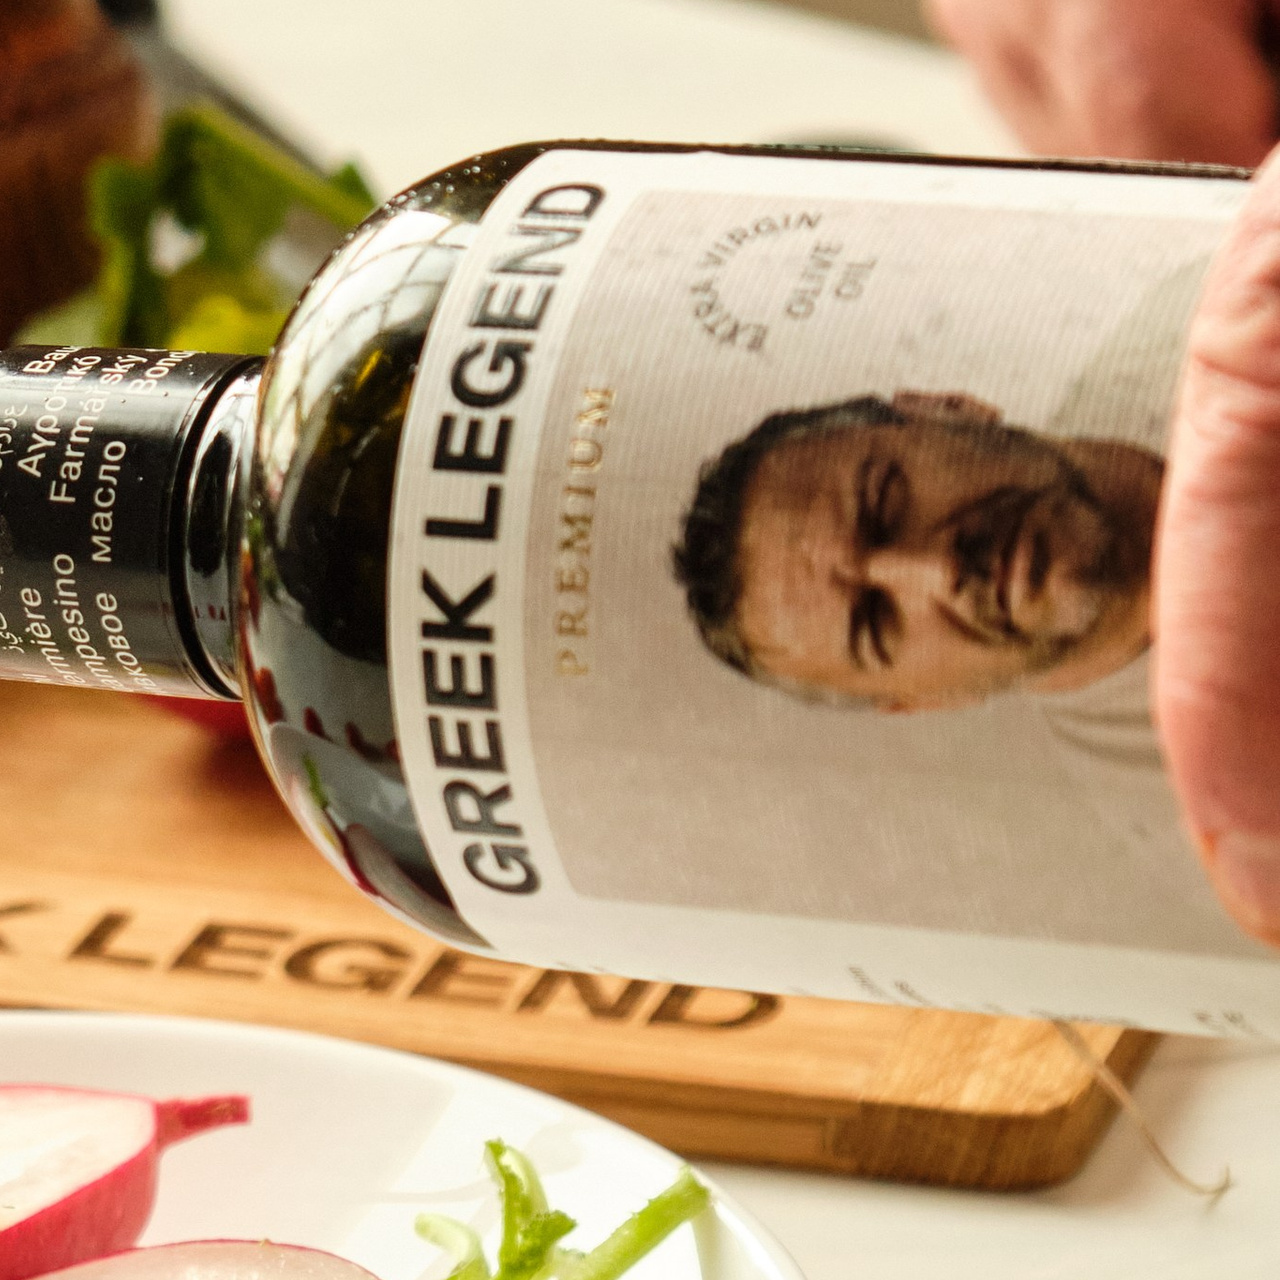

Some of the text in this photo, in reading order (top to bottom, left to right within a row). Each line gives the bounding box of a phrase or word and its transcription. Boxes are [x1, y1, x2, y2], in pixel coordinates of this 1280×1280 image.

[689, 213, 823, 353] EXTRA VIRGIN
[783, 242, 844, 321] OLIVE
[834, 258, 878, 300] OIL
[90, 440, 127, 563] масло
[421, 182, 606, 895] GREEK LEGEND
[554, 387, 617, 677] PREMIUM
[20, 587, 87, 686] ermière
[52, 553, 128, 693] ampesino
[66, 910, 785, 1031] LEGEND
